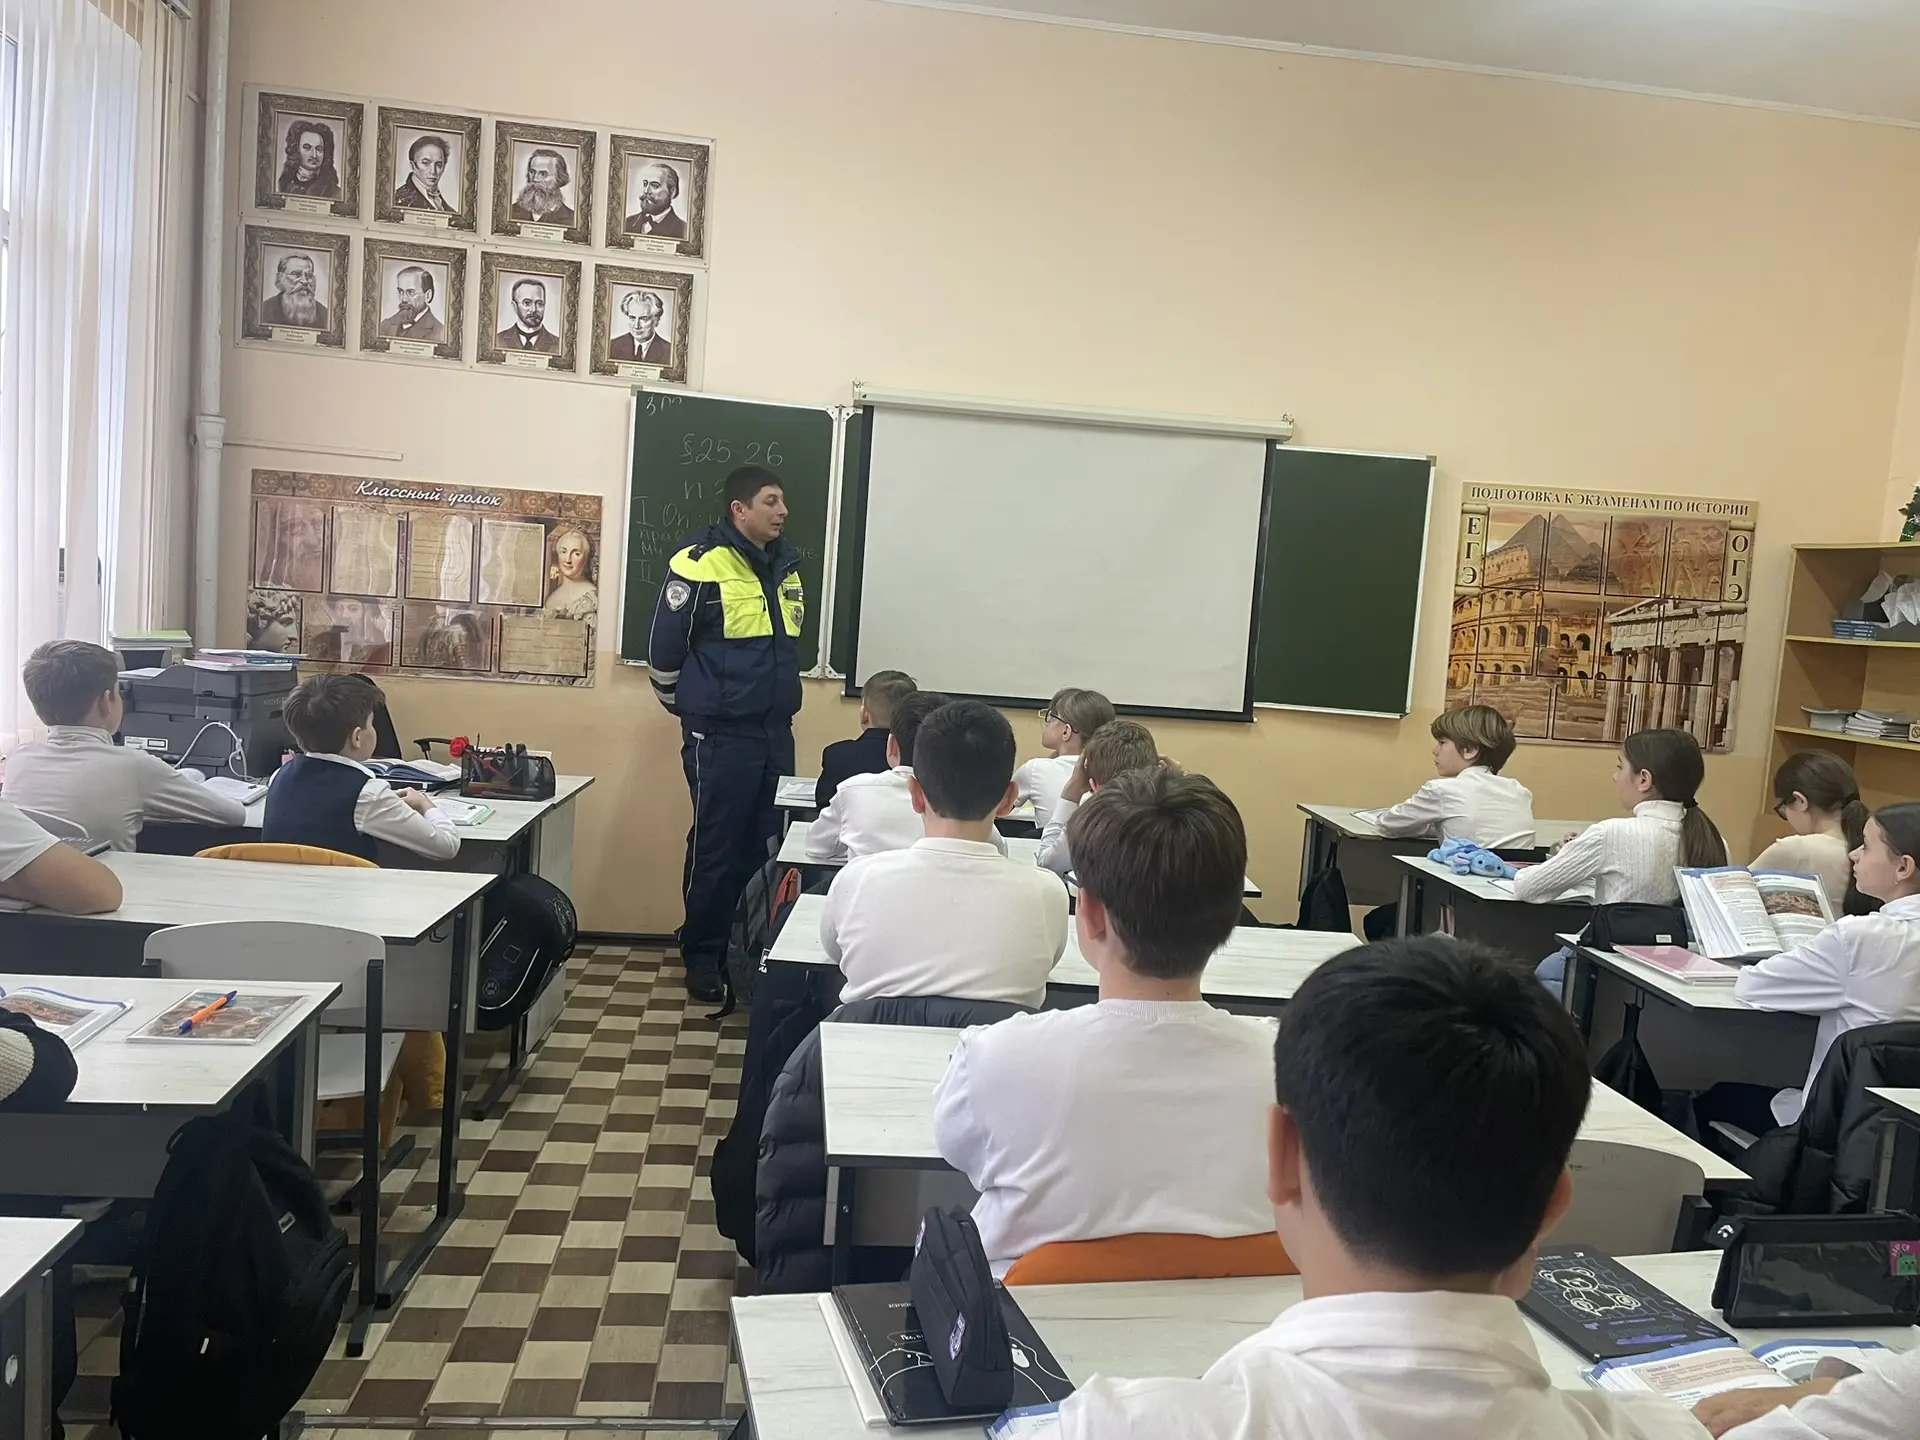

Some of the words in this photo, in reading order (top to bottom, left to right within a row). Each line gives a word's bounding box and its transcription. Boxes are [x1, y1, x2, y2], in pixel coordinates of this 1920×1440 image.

[355, 480, 443, 502] Классный
[448, 491, 501, 507] уголок
[1471, 486, 1560, 503] ПОДГОТОВКА
[1564, 493, 1574, 504] К
[1578, 494, 1660, 510] ЭКЗАМЕНАМ
[1664, 499, 1683, 512] ПО
[1686, 502, 1749, 516] ИСТОРИИ
[1463, 517, 1481, 585] ЕГЭ
[1728, 534, 1749, 601] ОГЭ
